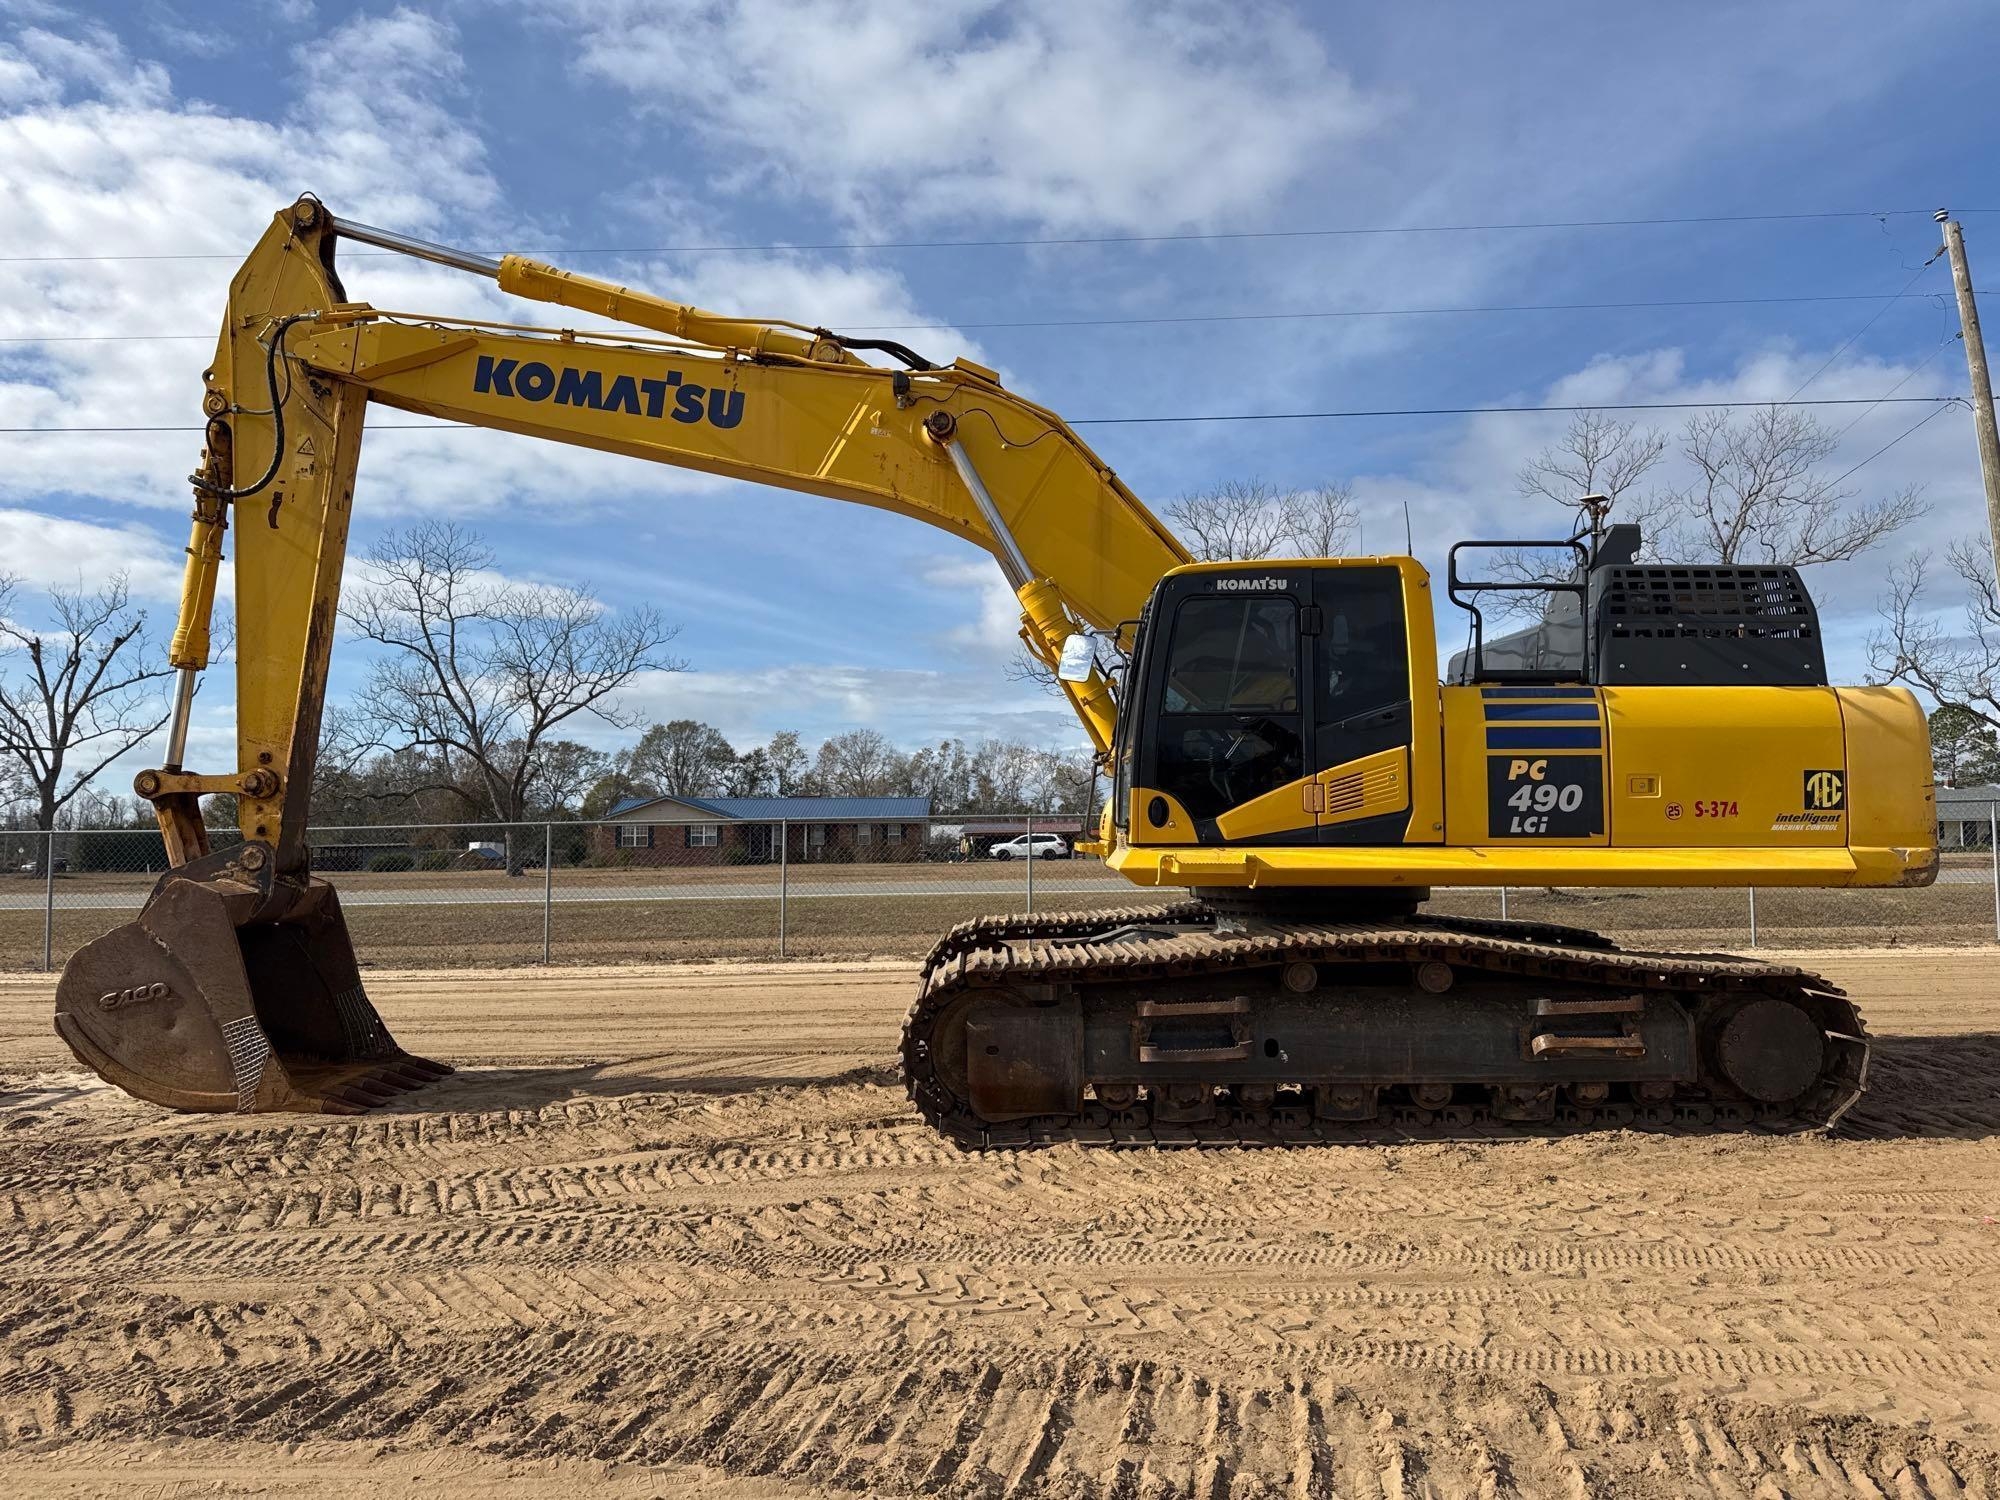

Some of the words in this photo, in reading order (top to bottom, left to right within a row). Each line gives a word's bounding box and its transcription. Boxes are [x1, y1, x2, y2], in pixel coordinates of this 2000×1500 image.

[473, 355, 746, 429] KOMATSU
[1216, 576, 1288, 590] KOMATSU
[1508, 759, 1548, 781] PC
[1507, 784, 1583, 813] 490
[1668, 805, 1680, 817] 25
[1695, 800, 1738, 818] S-374
[1510, 816, 1549, 833] LCi
[1775, 813, 1842, 825] intelligent
